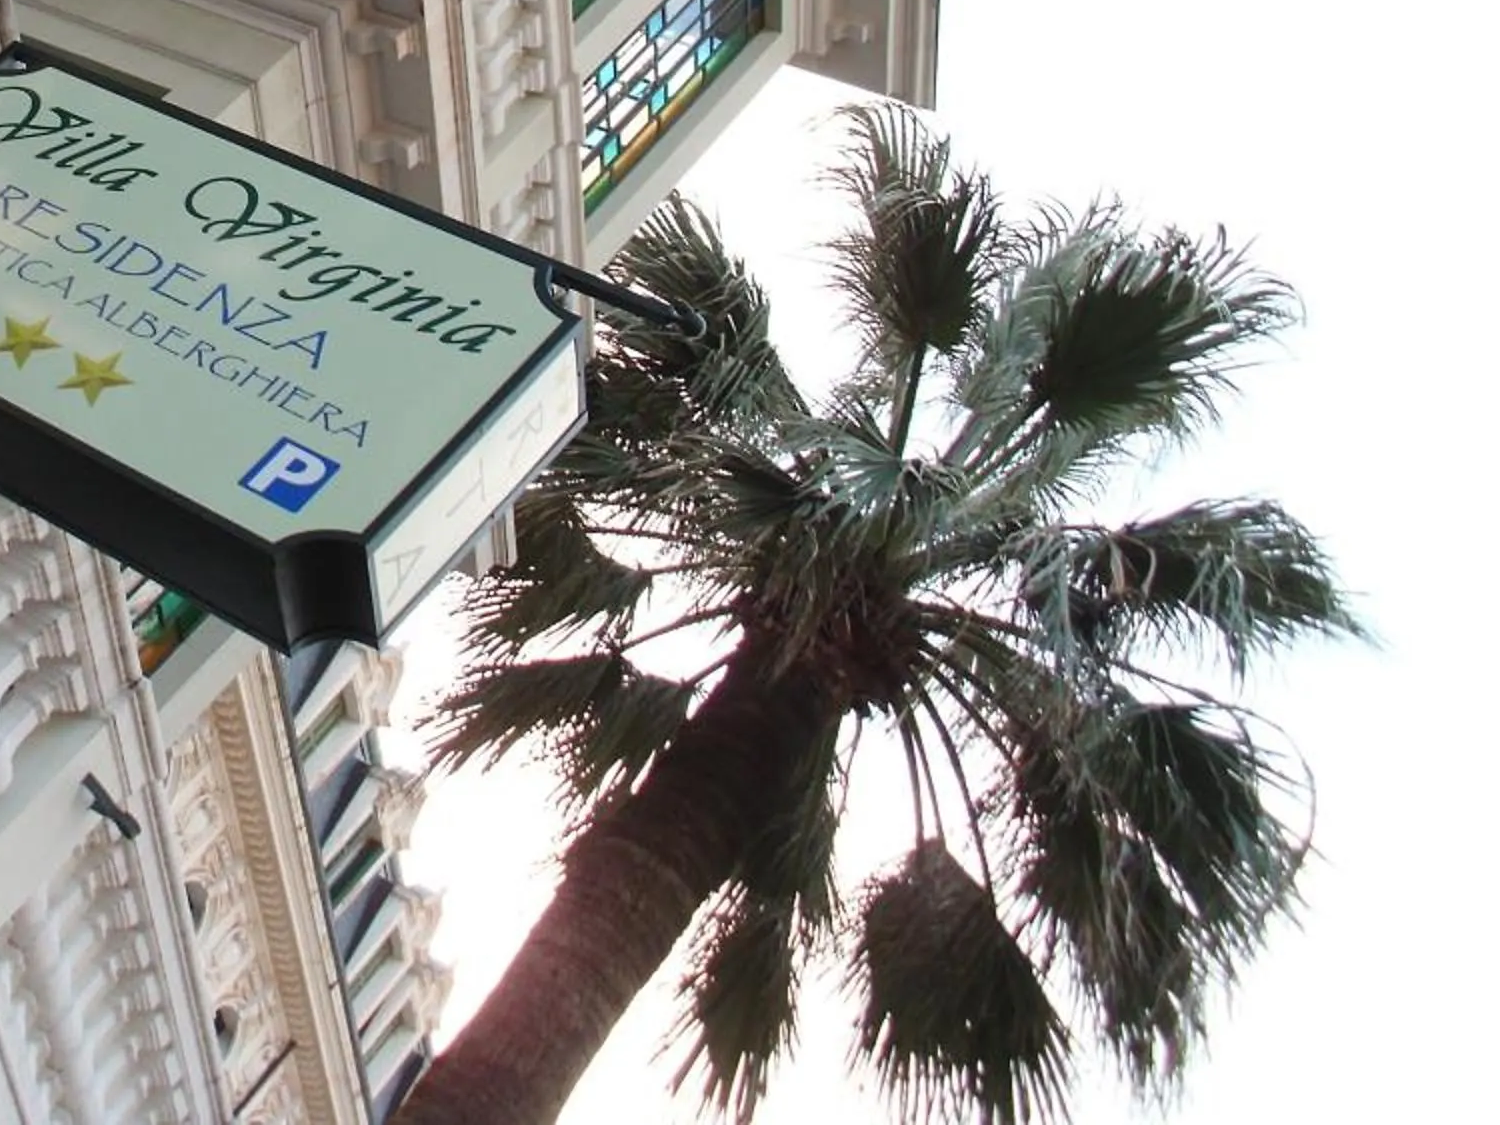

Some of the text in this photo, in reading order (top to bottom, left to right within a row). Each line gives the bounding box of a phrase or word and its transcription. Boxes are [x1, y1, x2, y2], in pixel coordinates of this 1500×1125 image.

[184, 176, 516, 353] Virginia
[74, 293, 368, 448] ALBERGHIERA
[248, 442, 327, 495] P
